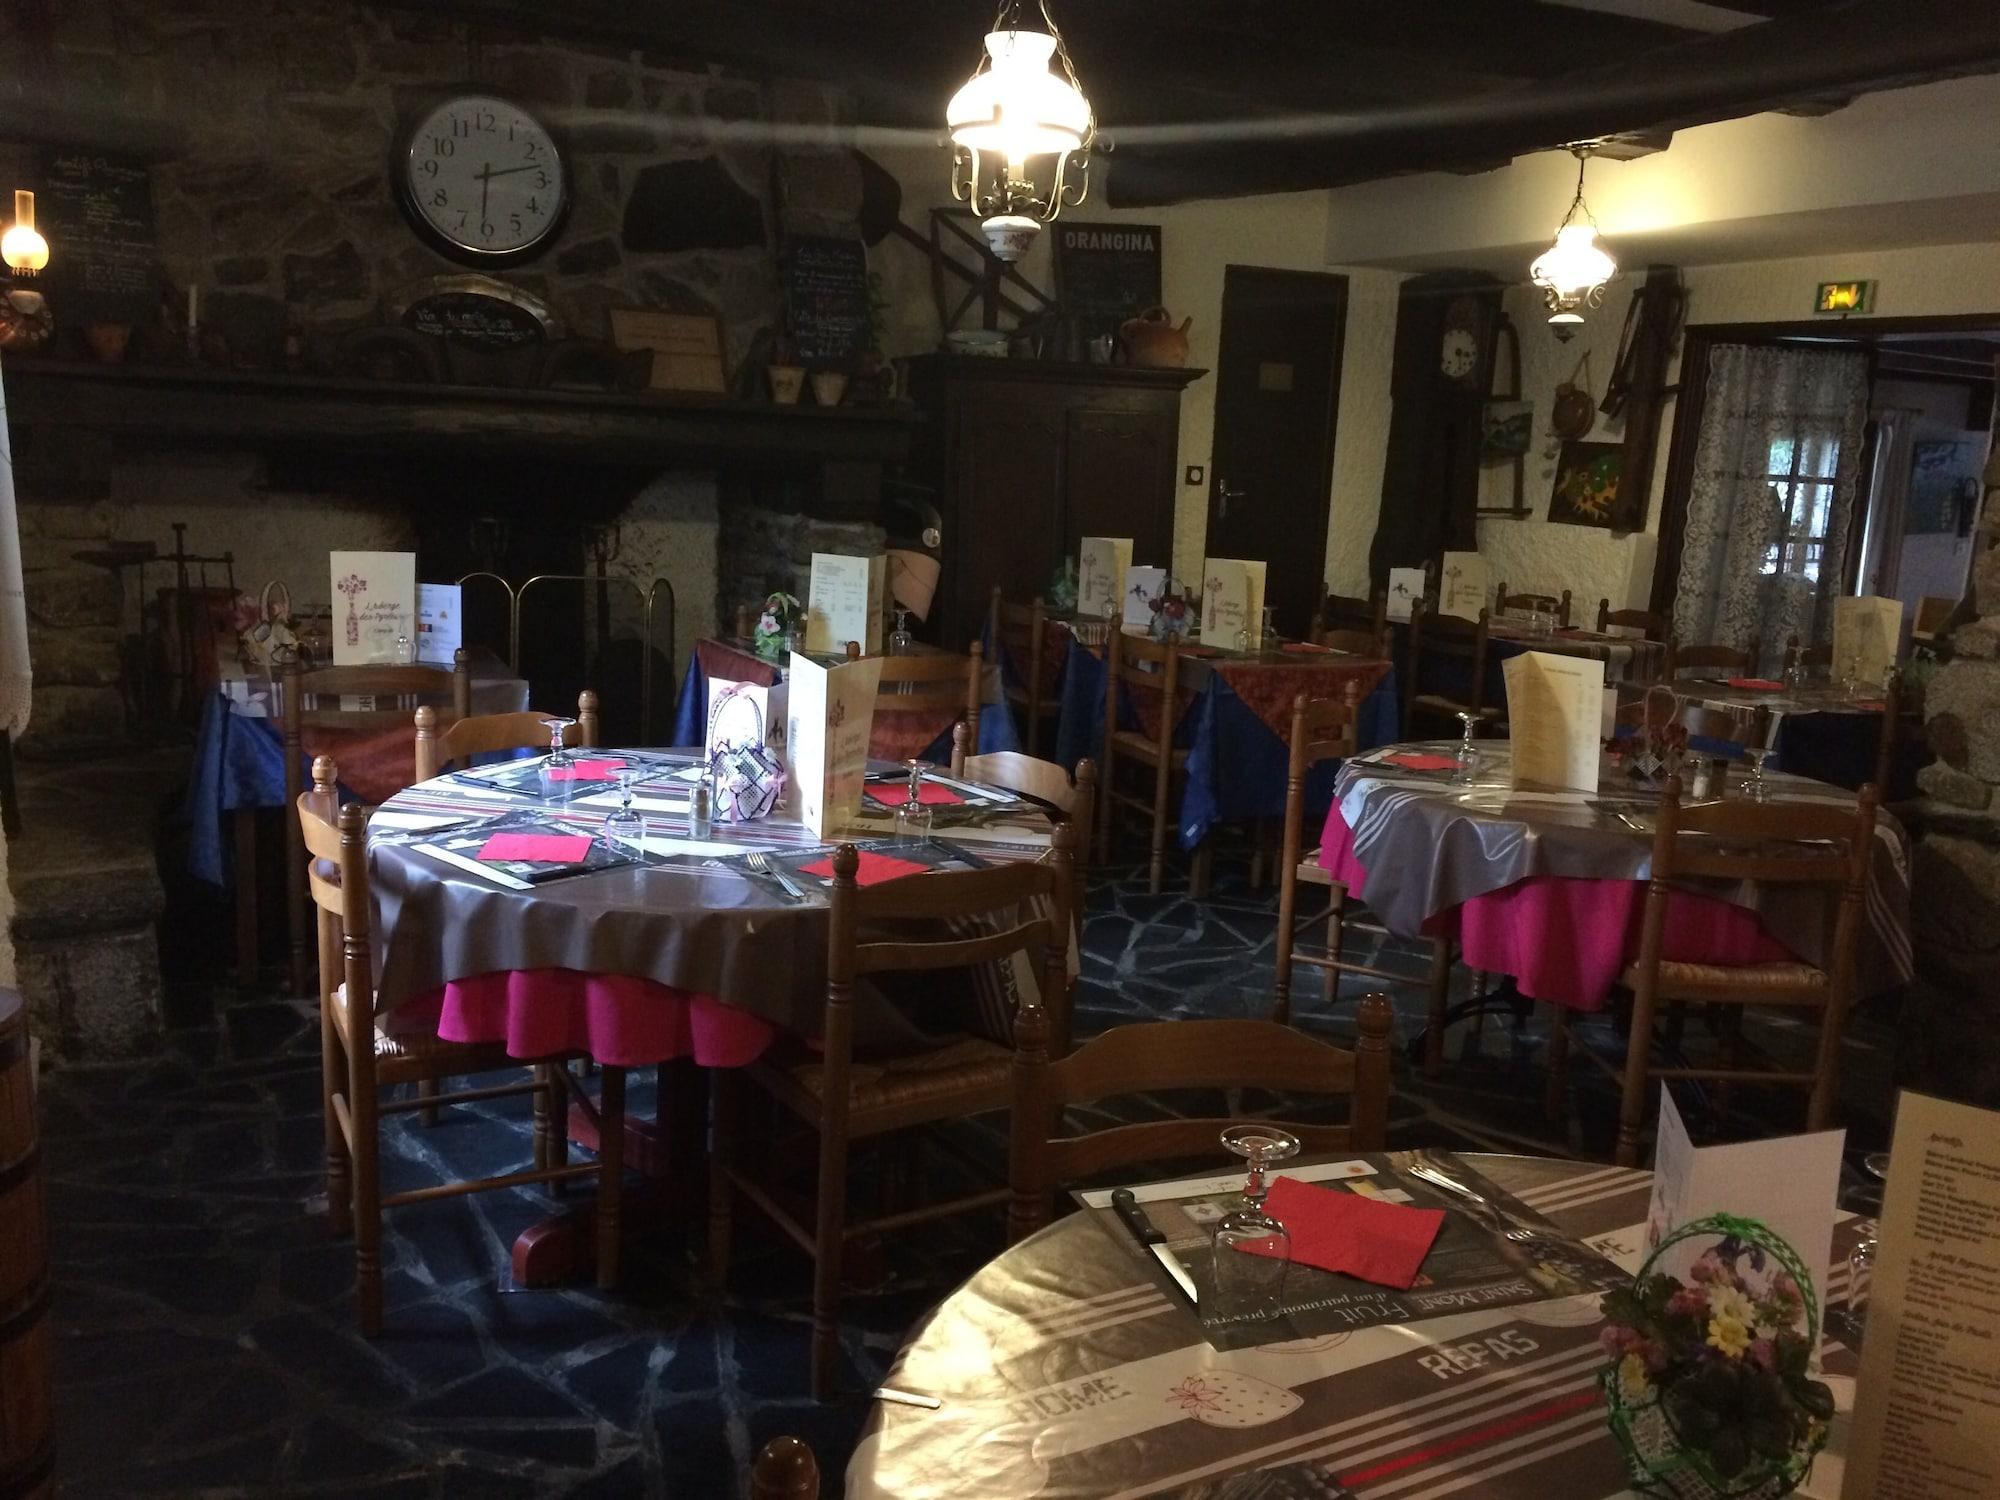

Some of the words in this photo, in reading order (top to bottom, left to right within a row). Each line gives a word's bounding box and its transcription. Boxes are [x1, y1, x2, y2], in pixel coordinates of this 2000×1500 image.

[453, 119, 468, 138] 11
[476, 113, 496, 133] 12
[508, 125, 514, 141] 1
[434, 137, 455, 158] 10
[524, 142, 536, 160] 2
[424, 159, 438, 178] 9
[534, 170, 547, 190] 3
[434, 188, 448, 207] 8
[526, 196, 539, 214] 4
[457, 210, 468, 228] 7
[480, 218, 494, 237] 6
[510, 214, 521, 232] 5
[1065, 232, 1154, 252] ORANGINA
[1418, 1329, 1540, 1379] REPAS
[1006, 1376, 1132, 1422] HOME
